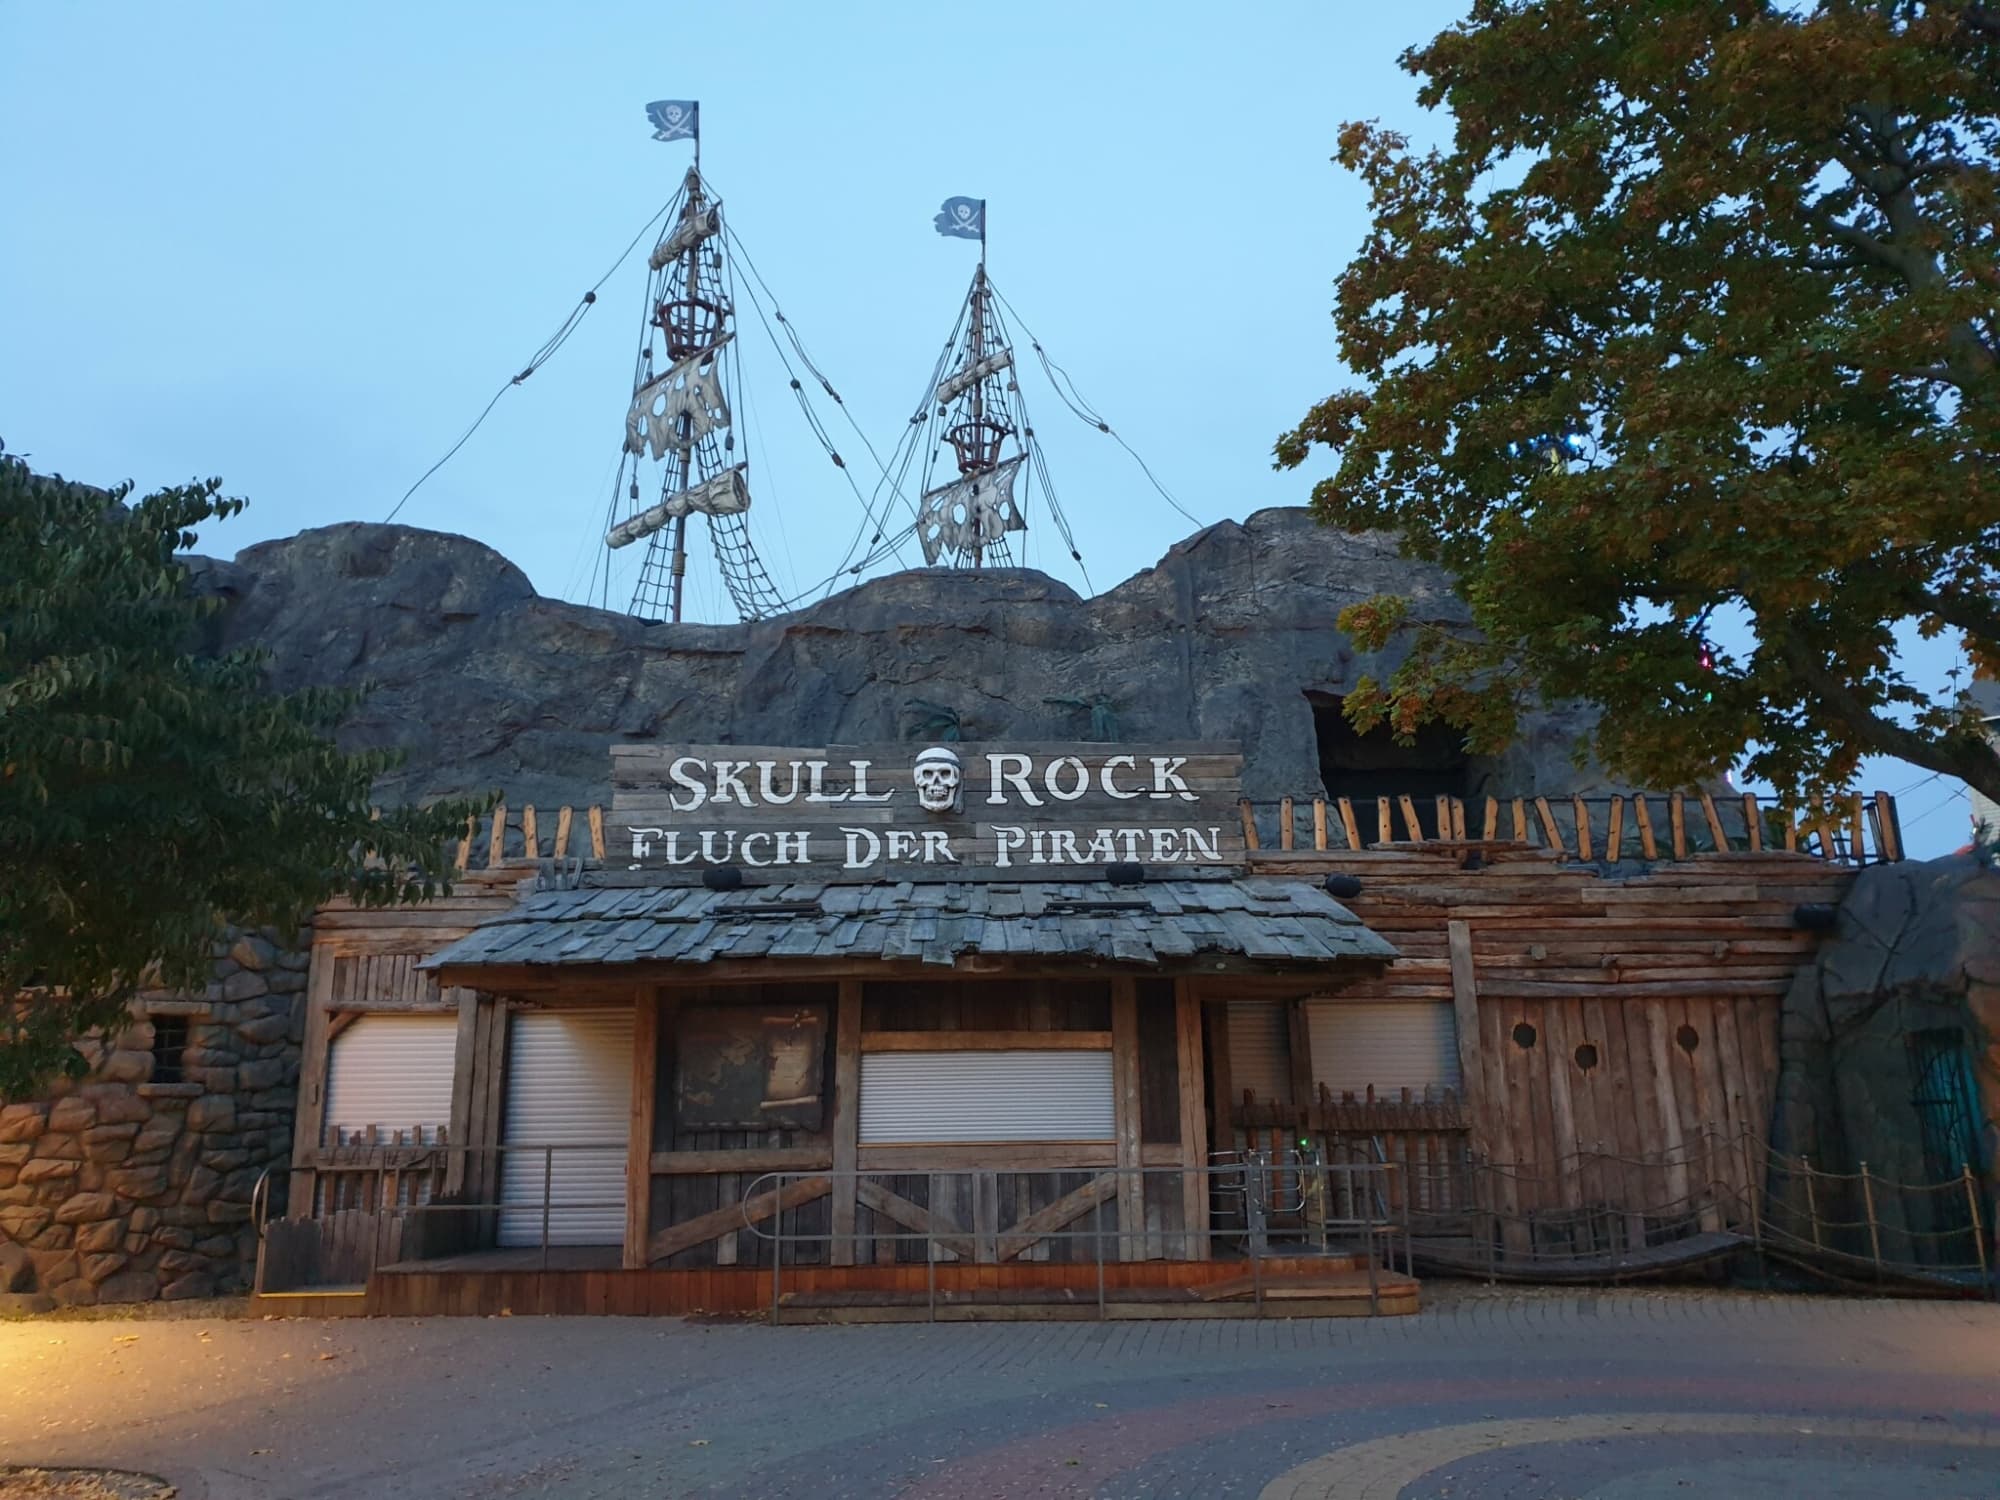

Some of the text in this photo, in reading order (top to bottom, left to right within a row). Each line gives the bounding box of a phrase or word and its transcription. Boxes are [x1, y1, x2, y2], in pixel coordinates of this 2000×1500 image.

[669, 752, 1200, 811] SKULL ROCK
[628, 824, 1223, 870] FLUCH DER PIRATEN
